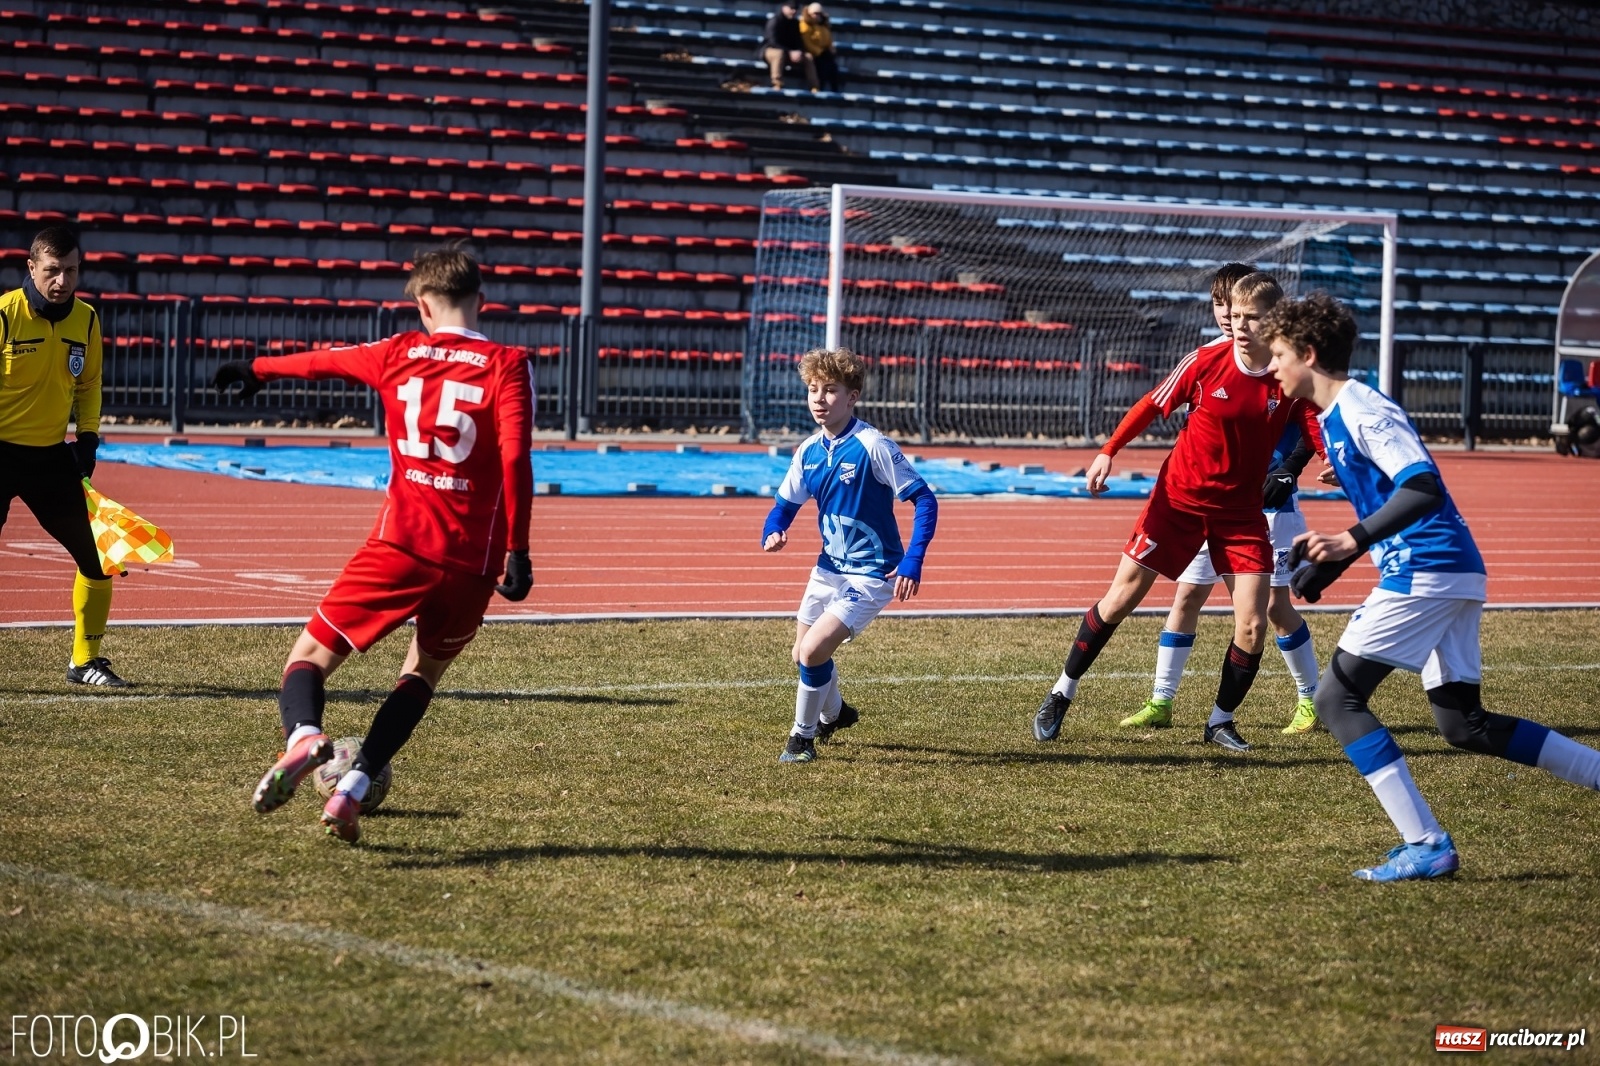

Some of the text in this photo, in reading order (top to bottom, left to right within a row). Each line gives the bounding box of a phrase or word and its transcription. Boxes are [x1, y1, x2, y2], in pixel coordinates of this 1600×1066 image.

[447, 349, 488, 368] ZABRZE
[396, 376, 485, 464] 15
[1129, 533, 1158, 560] 17
